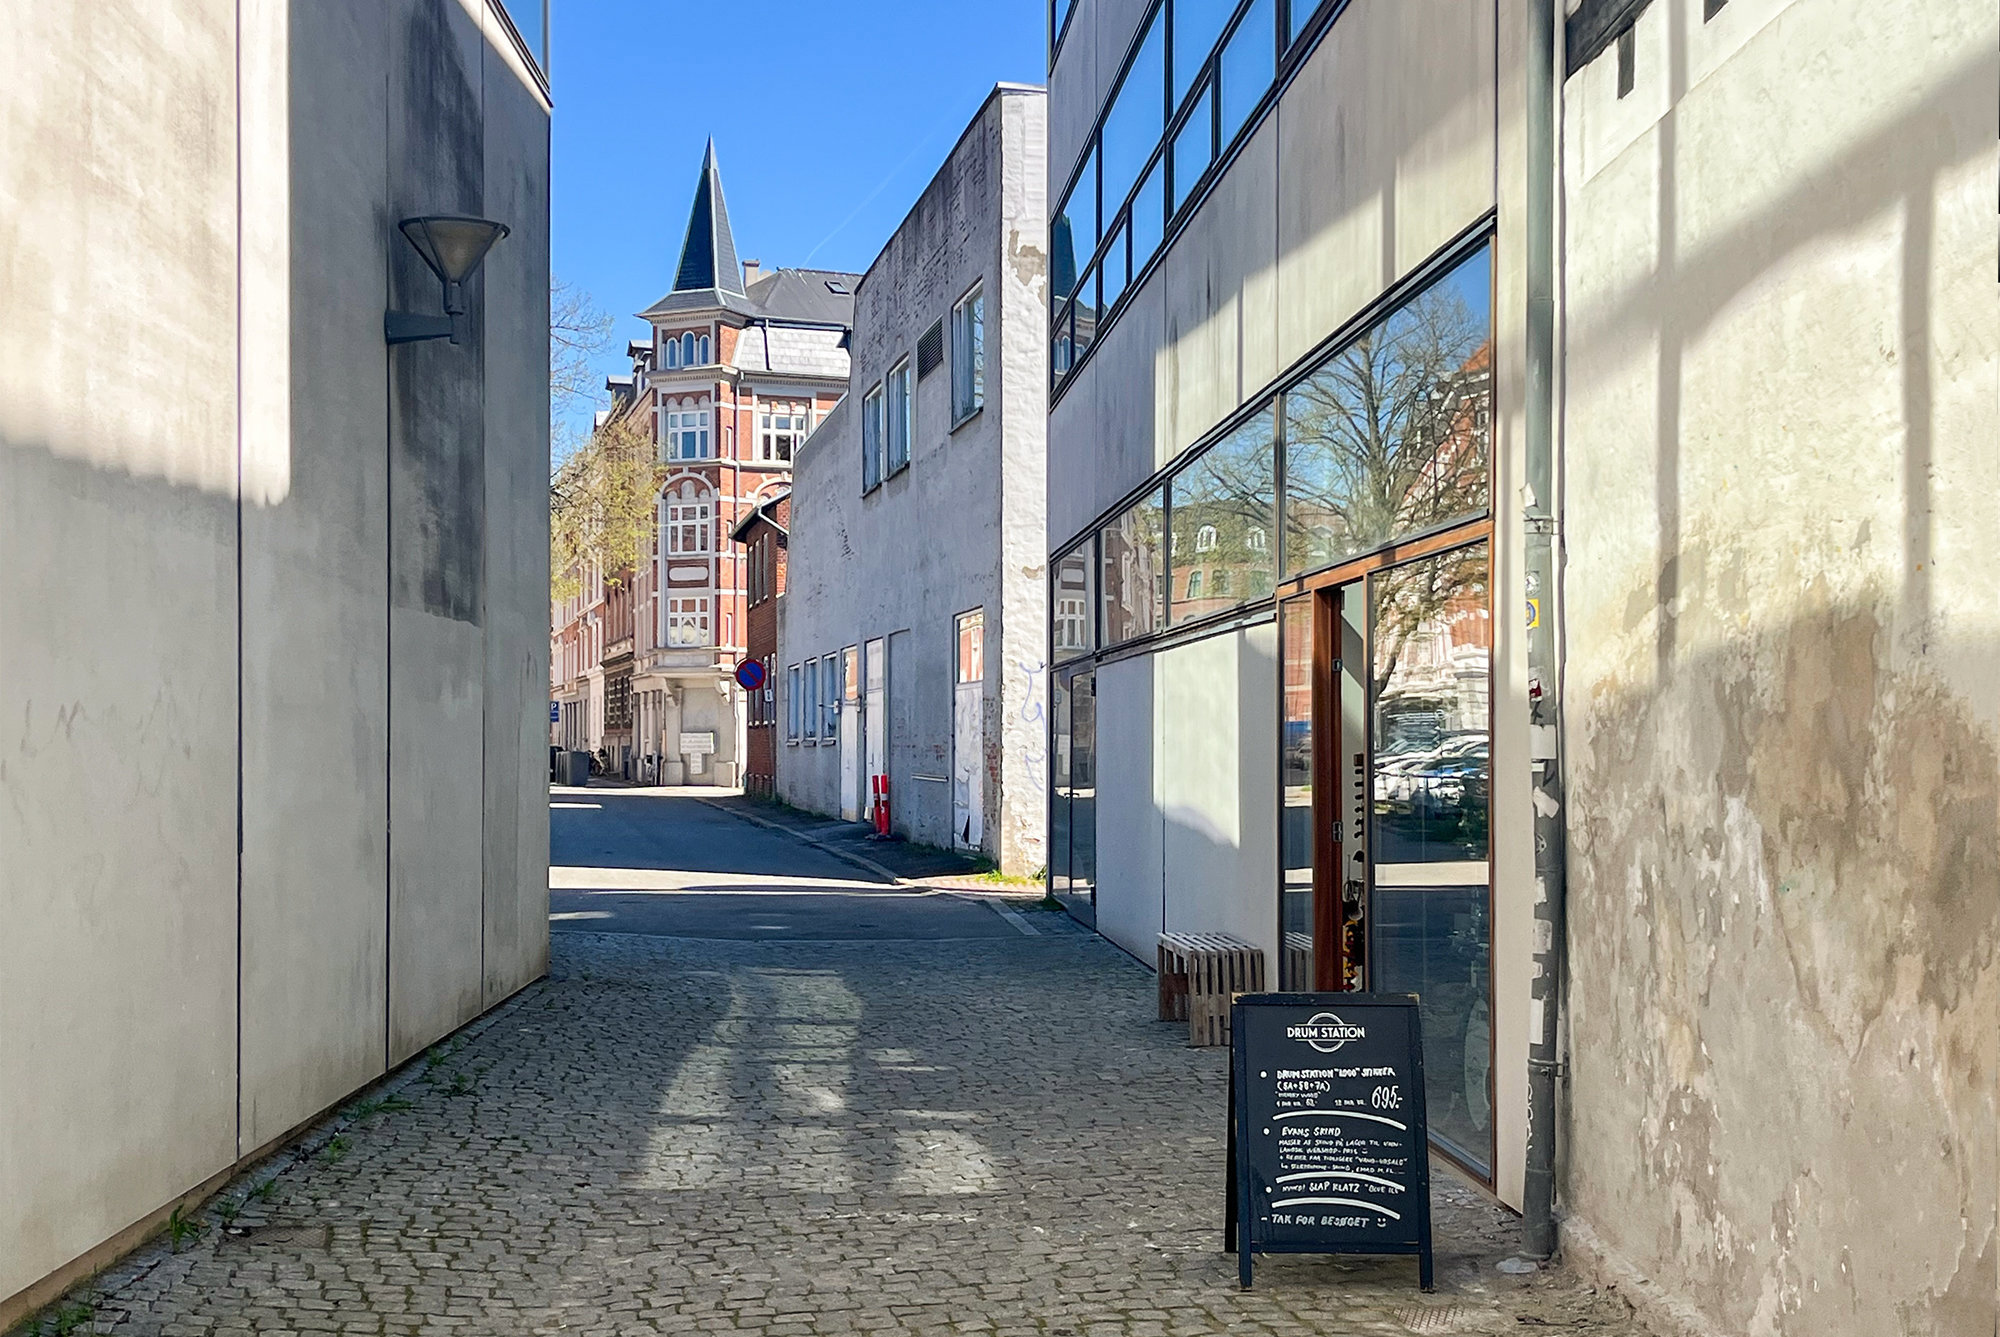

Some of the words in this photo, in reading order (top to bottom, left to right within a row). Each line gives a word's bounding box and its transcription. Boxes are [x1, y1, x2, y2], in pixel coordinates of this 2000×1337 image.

[1286, 1027, 1318, 1038] DRUM
[1321, 1027, 1365, 1038] STATION
[1277, 1070, 1300, 1079] DRUM
[1301, 1069, 1334, 1078] STATION
[1282, 1126, 1310, 1137] EVANS
[1313, 1127, 1341, 1136] SKIND
[1309, 1181, 1330, 1192] SLAP
[1332, 1183, 1360, 1193] KLATZ
[1271, 1214, 1291, 1224] TAK
[1295, 1215, 1315, 1226] FOR
